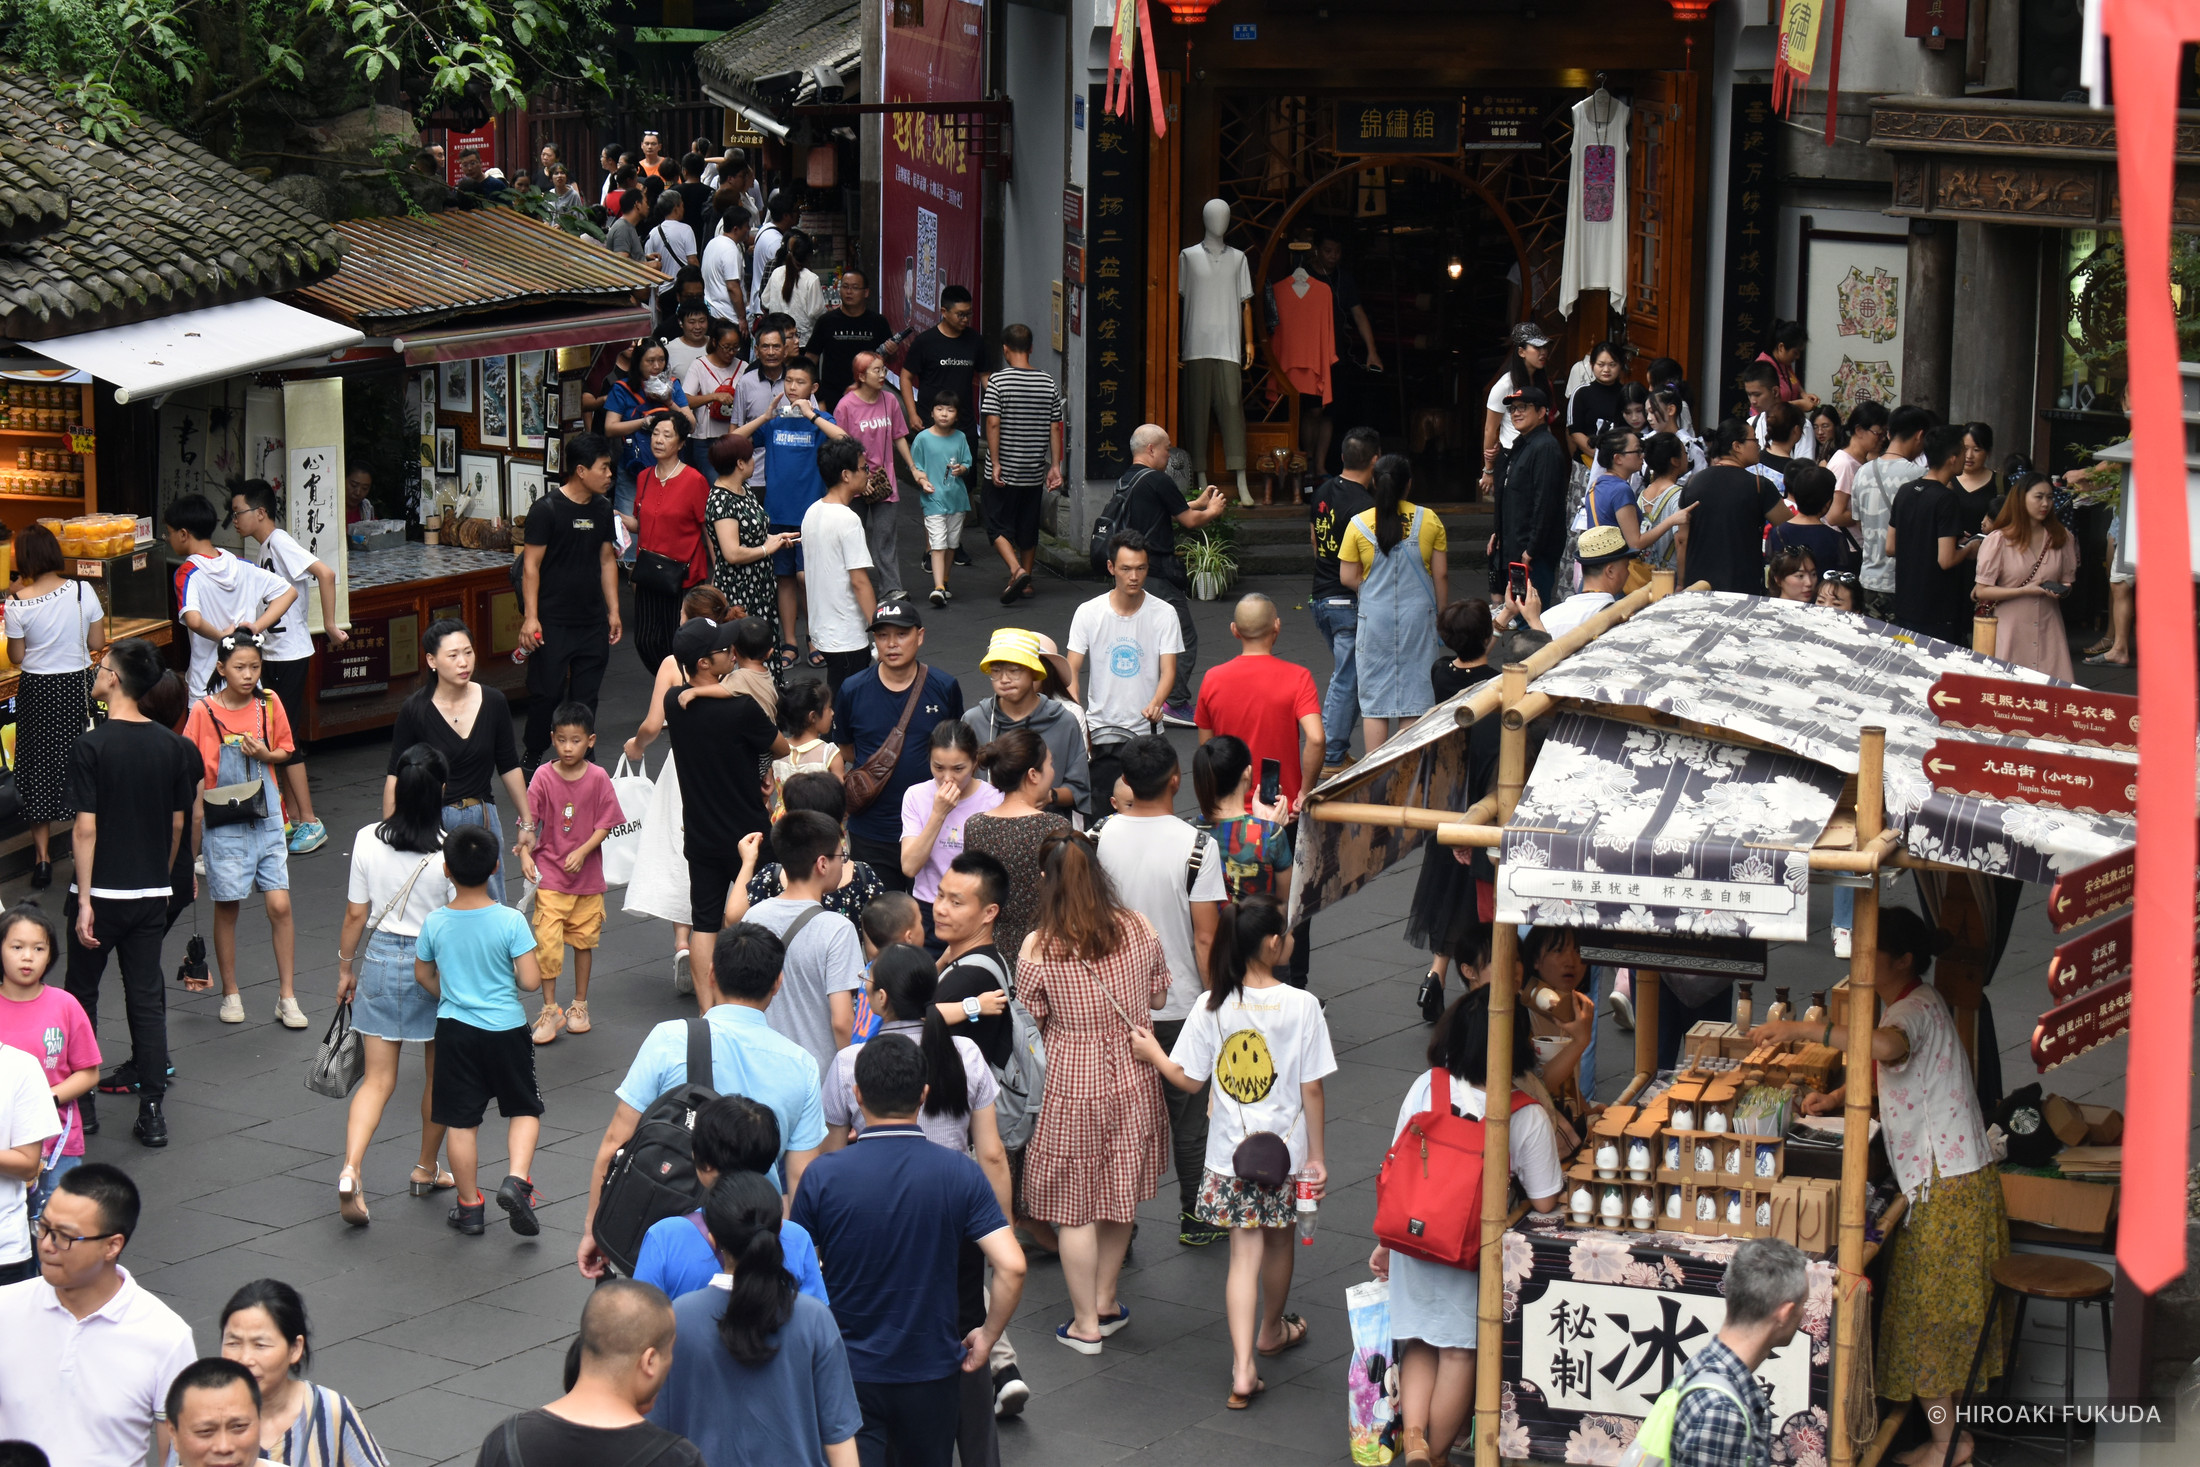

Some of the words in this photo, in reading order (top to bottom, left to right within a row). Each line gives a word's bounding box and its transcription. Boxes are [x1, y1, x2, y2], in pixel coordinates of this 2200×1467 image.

[877, 605, 901, 618] FILA
[1981, 692, 2048, 713] 延熙大道
[2063, 703, 2116, 721] 乌衣巷
[1993, 710, 2010, 720] Yanxi
[2011, 712, 2034, 723] Avenue
[2072, 720, 2089, 732] Wuyi
[2090, 723, 2106, 733] Lane
[2017, 782, 2039, 794] Jiupin
[2040, 785, 2061, 796] Street
[2084, 864, 2134, 894] 安全疏散出口
[44, 1027, 60, 1042] ALL
[2057, 1012, 2091, 1038] 锦里出口
[47, 1037, 63, 1056] DAY
[1547, 1299, 1597, 1401] 秘制
[1597, 1295, 1709, 1405] 冰
